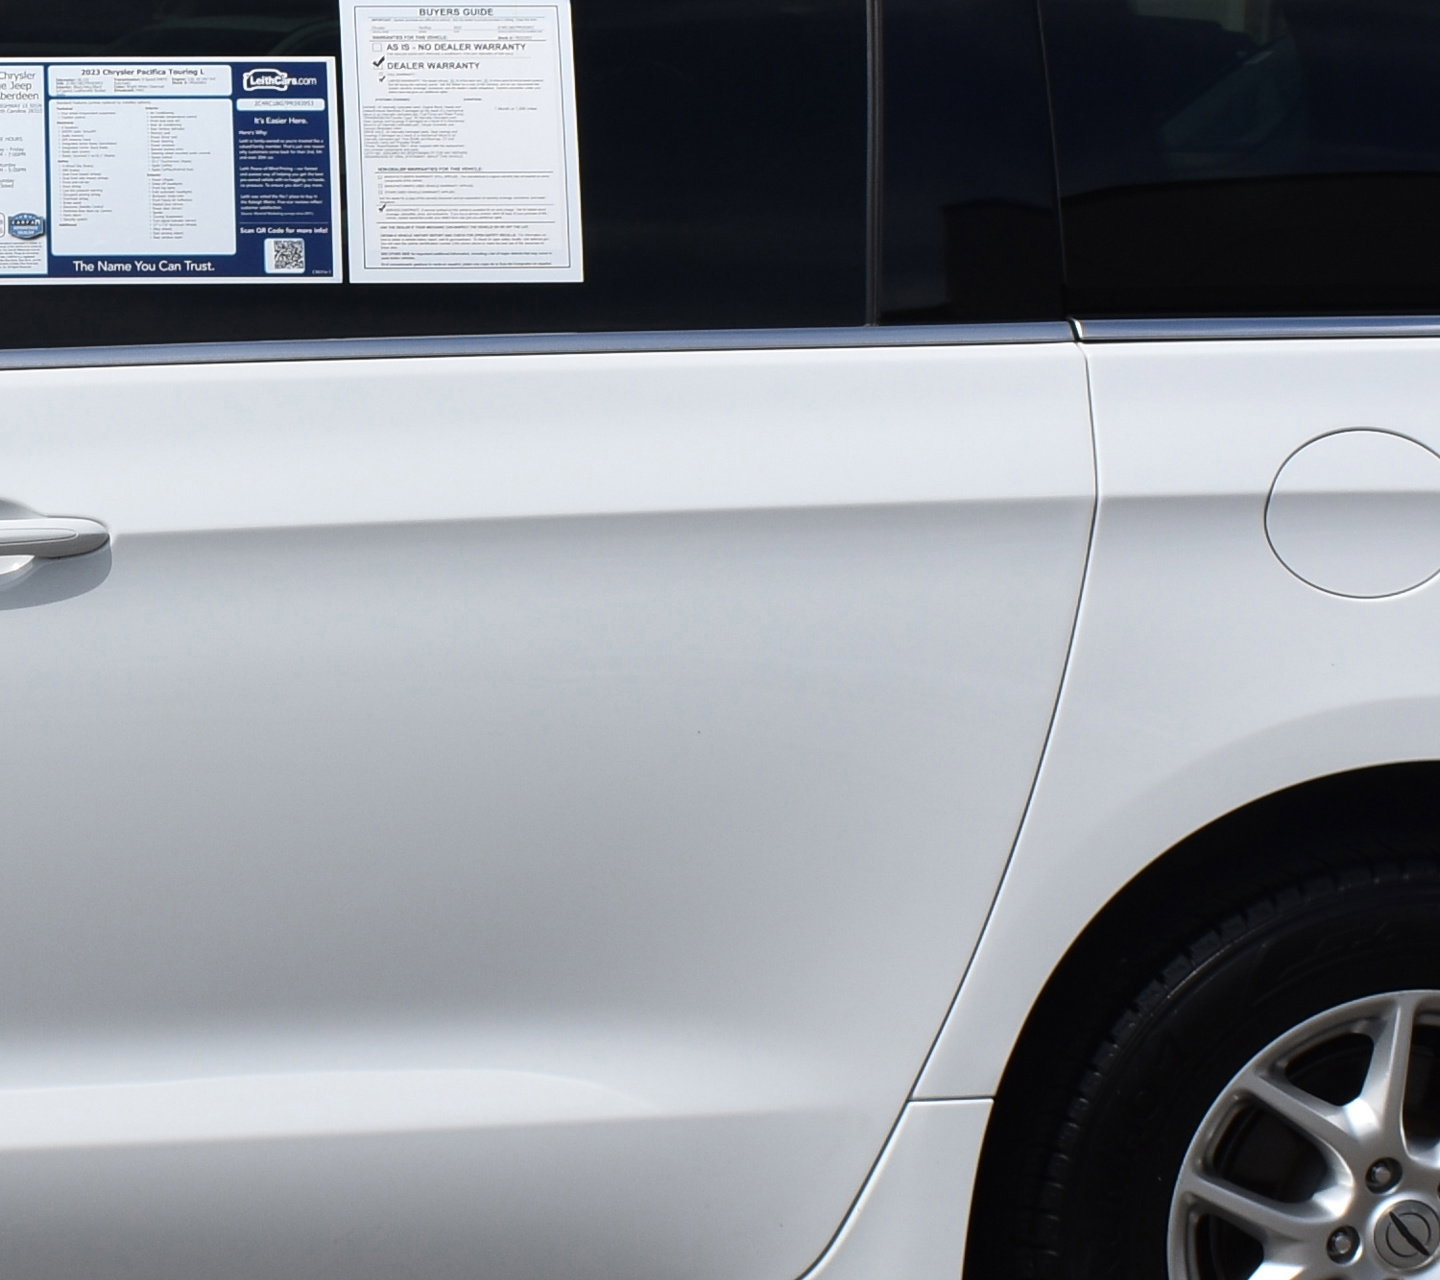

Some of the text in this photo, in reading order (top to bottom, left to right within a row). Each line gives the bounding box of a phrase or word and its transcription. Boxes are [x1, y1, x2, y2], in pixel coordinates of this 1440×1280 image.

[419, 8, 494, 17] BUYERS GUIDE
[386, 43, 400, 51] AS
[402, 43, 411, 51] IS
[418, 43, 432, 51] NO
[434, 43, 472, 51] DEALER
[473, 43, 526, 51] WARRANTY
[386, 62, 480, 70] DEALER WARRANTY
[250, 75, 318, 86] LeithCars.com
[10, 81, 32, 91] Jeep
[73, 260, 215, 272] The Name You Can Trust.
